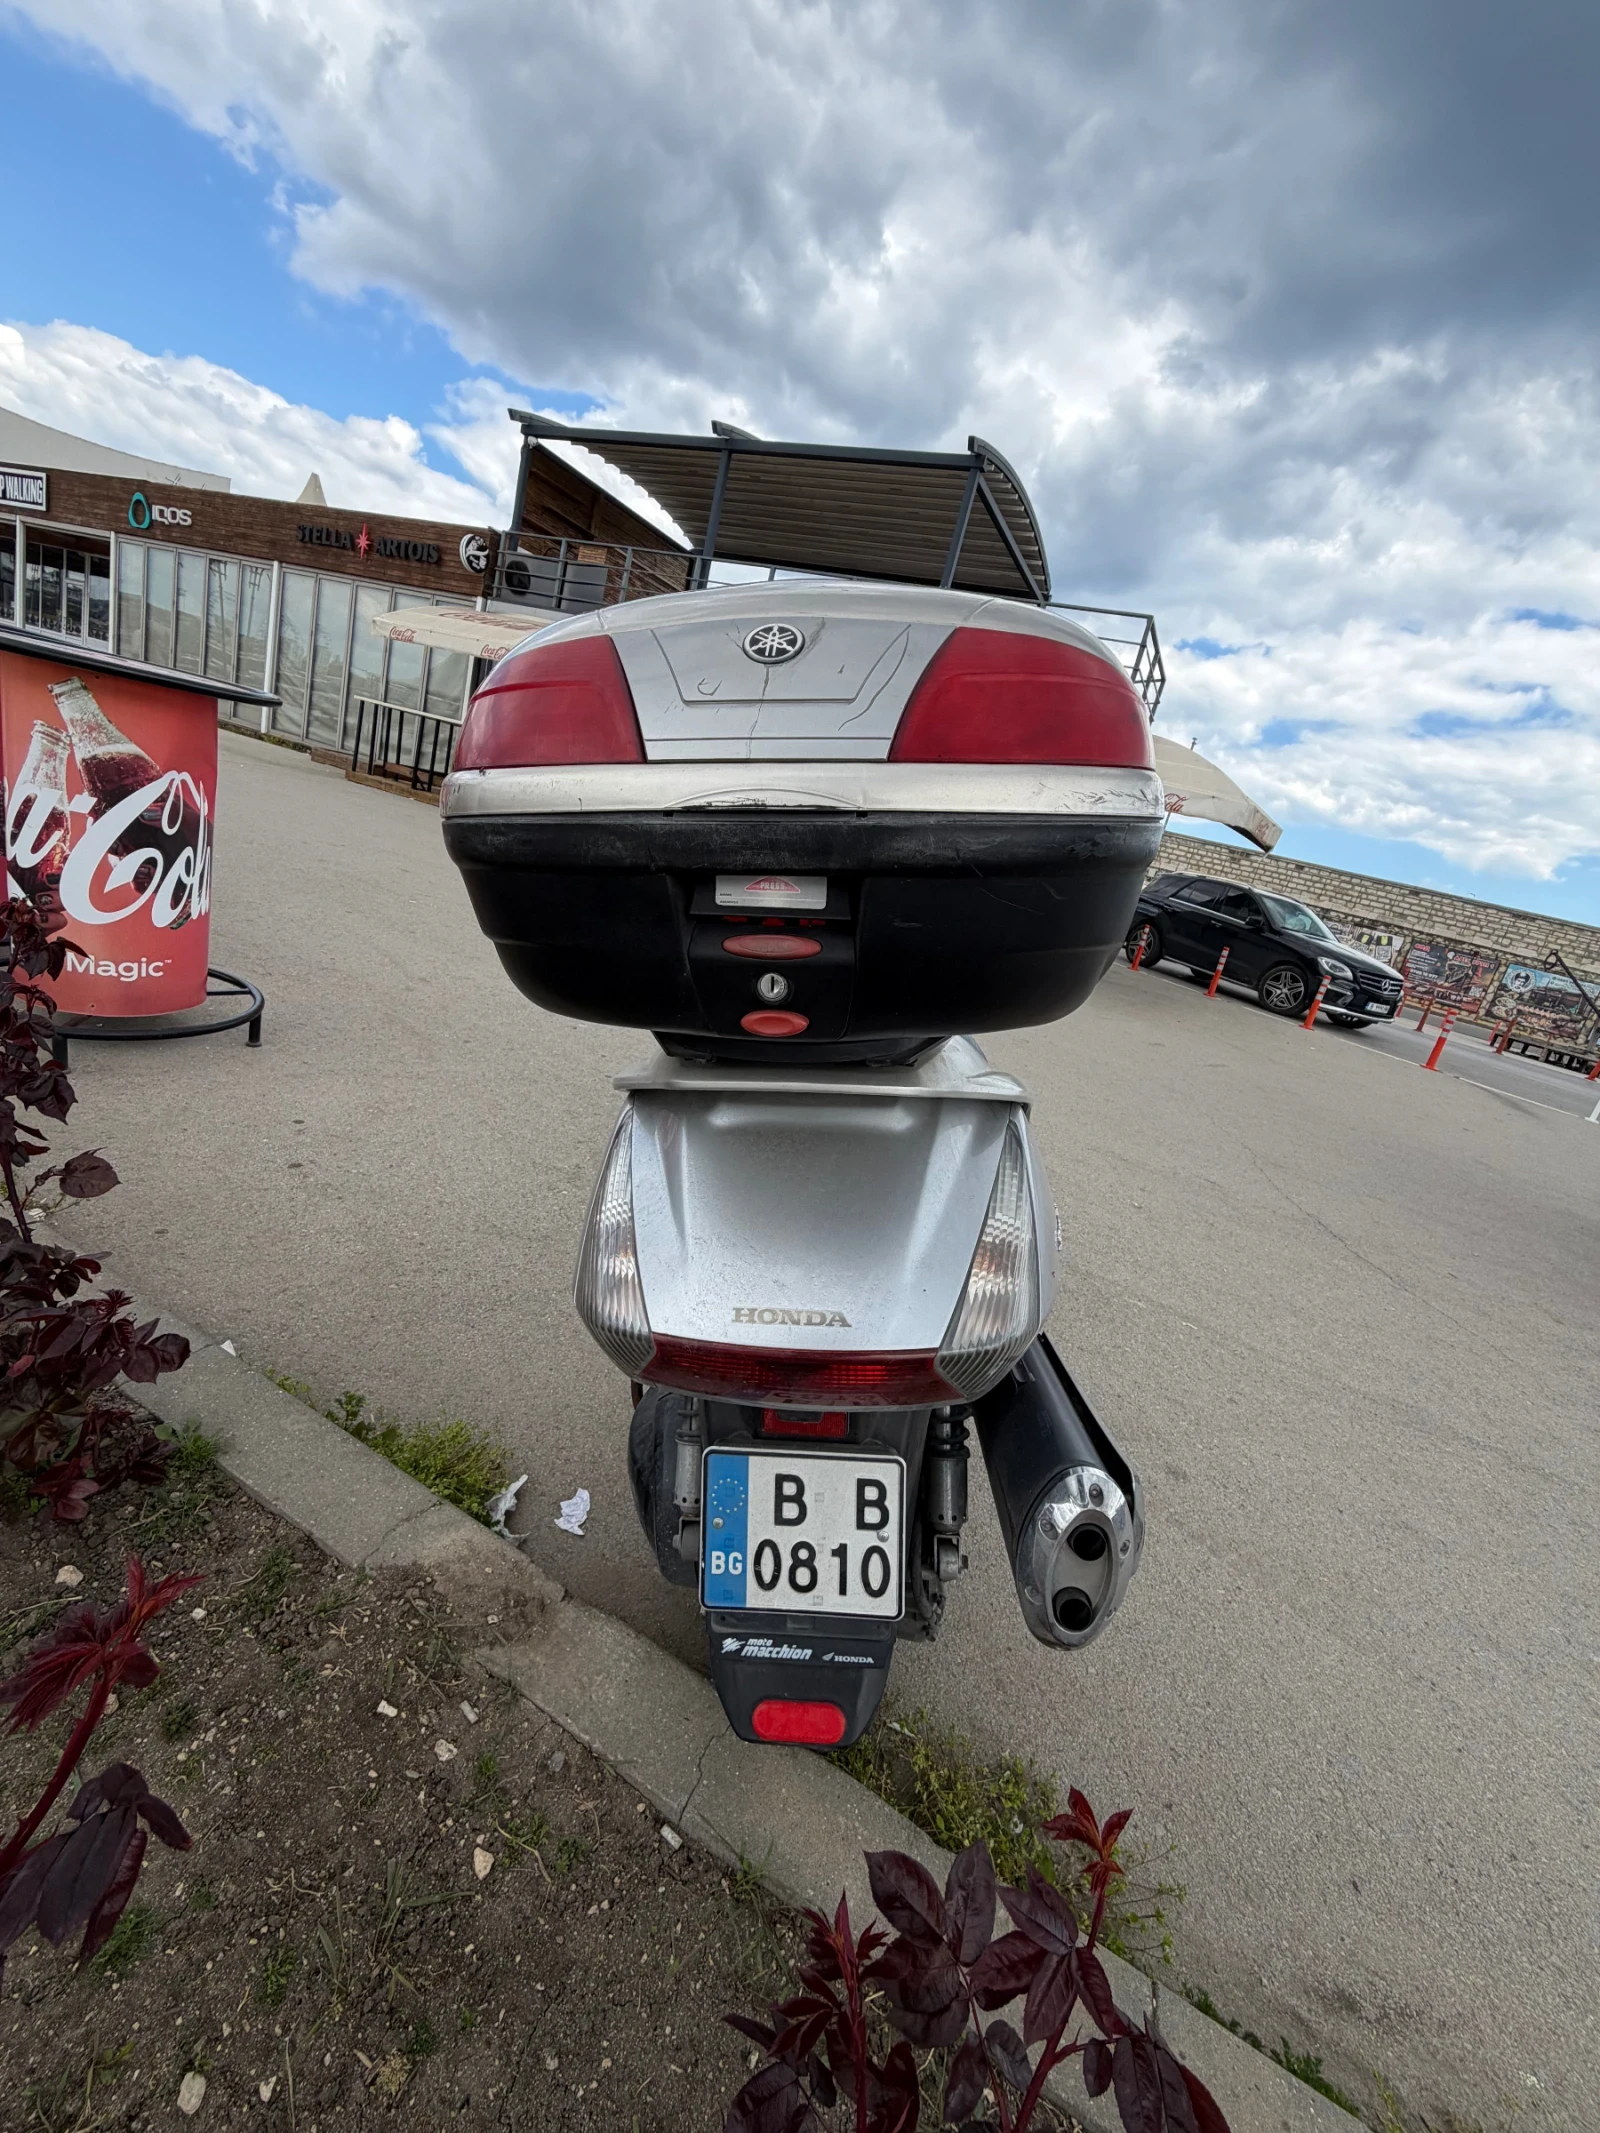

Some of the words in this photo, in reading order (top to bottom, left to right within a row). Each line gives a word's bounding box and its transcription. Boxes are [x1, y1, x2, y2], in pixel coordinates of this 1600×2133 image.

[5, 475, 43, 503] WALKING
[152, 505, 192, 526] IQOS
[297, 525, 353, 549] STELLA
[375, 536, 440, 563] ARTOIS
[732, 1307, 852, 1328] HONDA
[774, 1473, 807, 1526] B
[856, 1478, 890, 1530] B
[711, 1551, 743, 1575] BG
[754, 1539, 891, 1598] 0810
[741, 1644, 813, 1660] macchion
[747, 1638, 773, 1647] moto
[834, 1655, 875, 1664] HONDA
